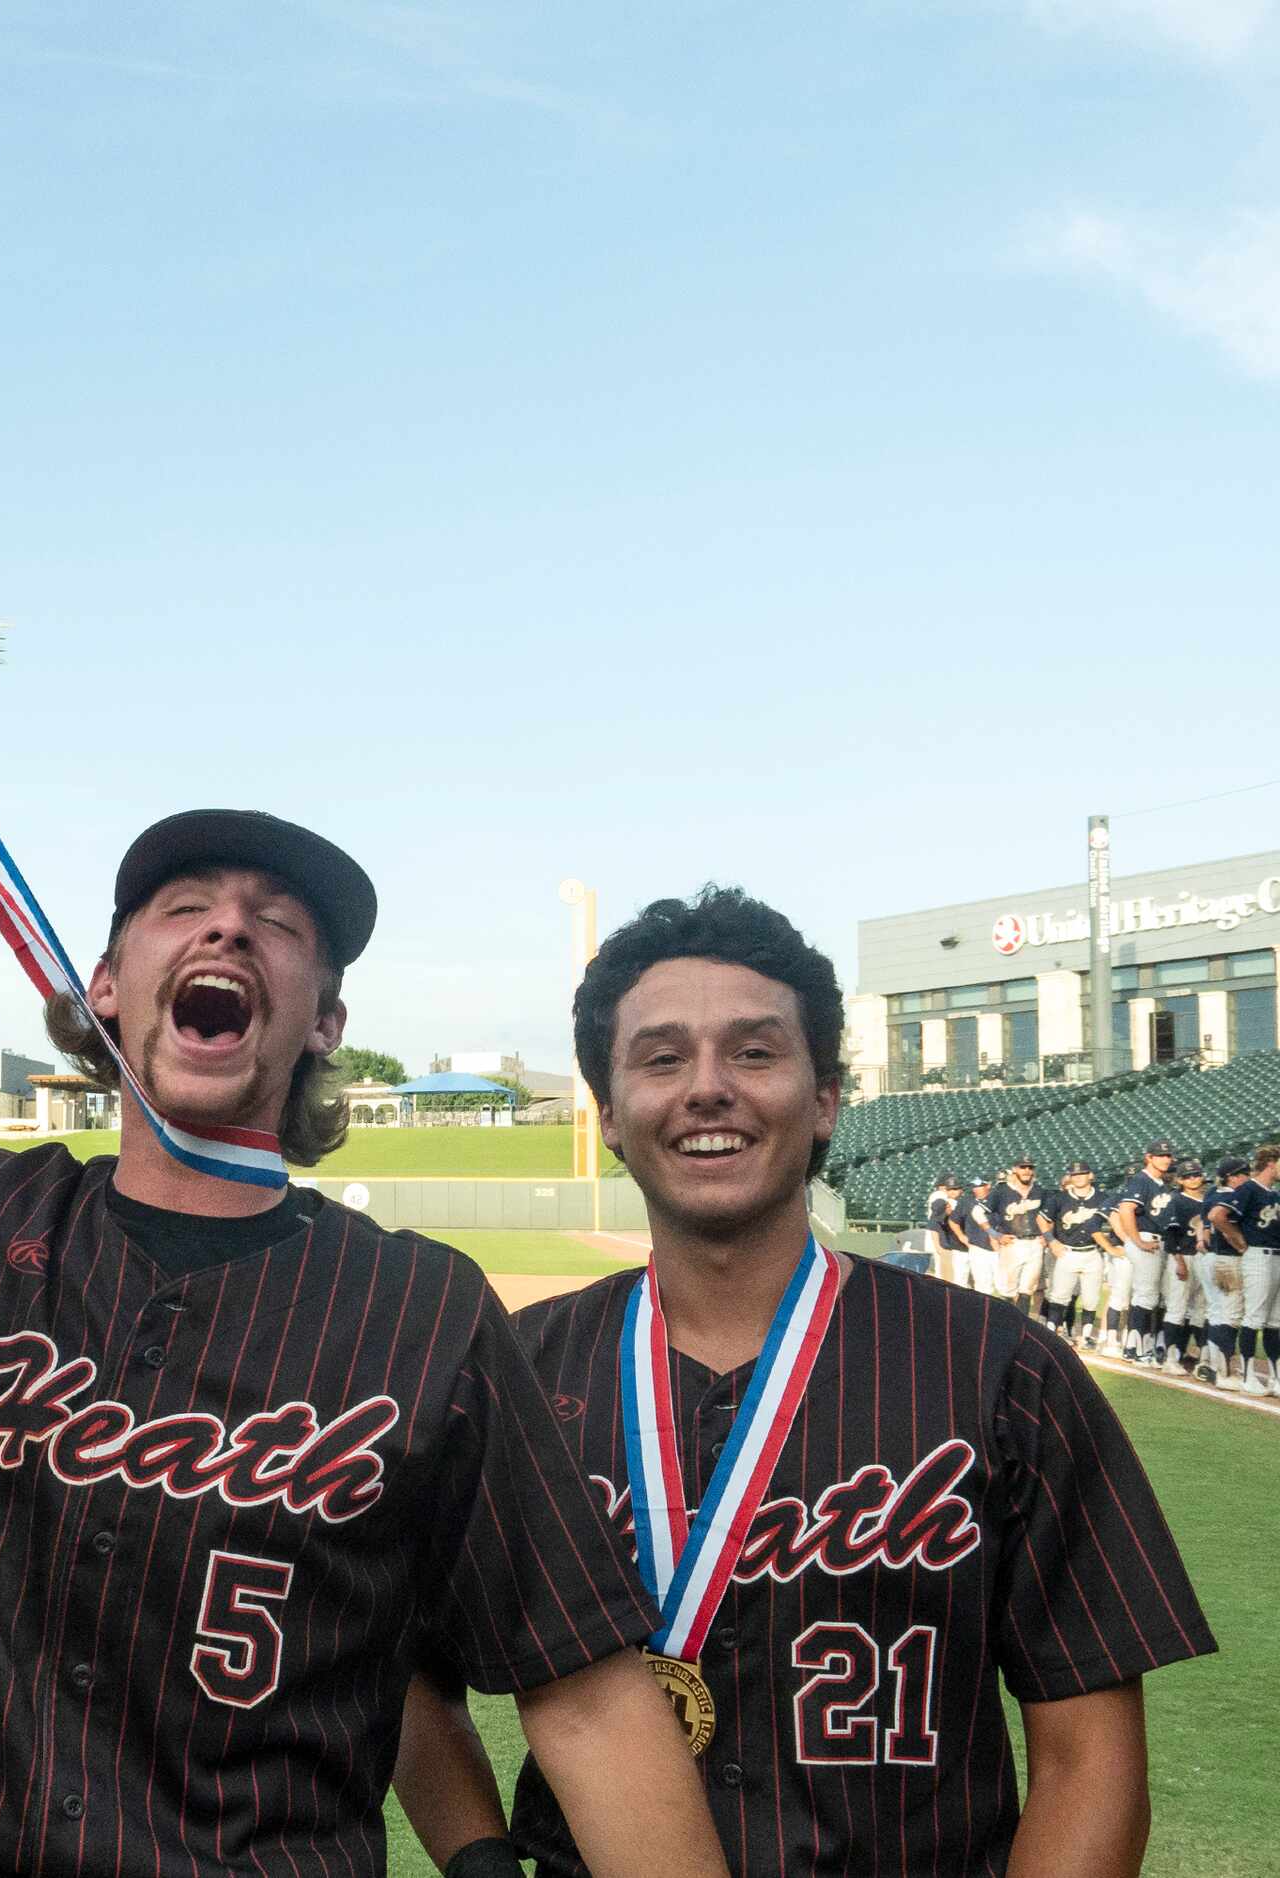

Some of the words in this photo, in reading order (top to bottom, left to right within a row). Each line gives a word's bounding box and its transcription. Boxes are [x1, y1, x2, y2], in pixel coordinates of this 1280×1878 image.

[1123, 890, 1257, 931] Heritage
[189, 1549, 294, 1709] 5
[791, 1621, 938, 1766] 21
